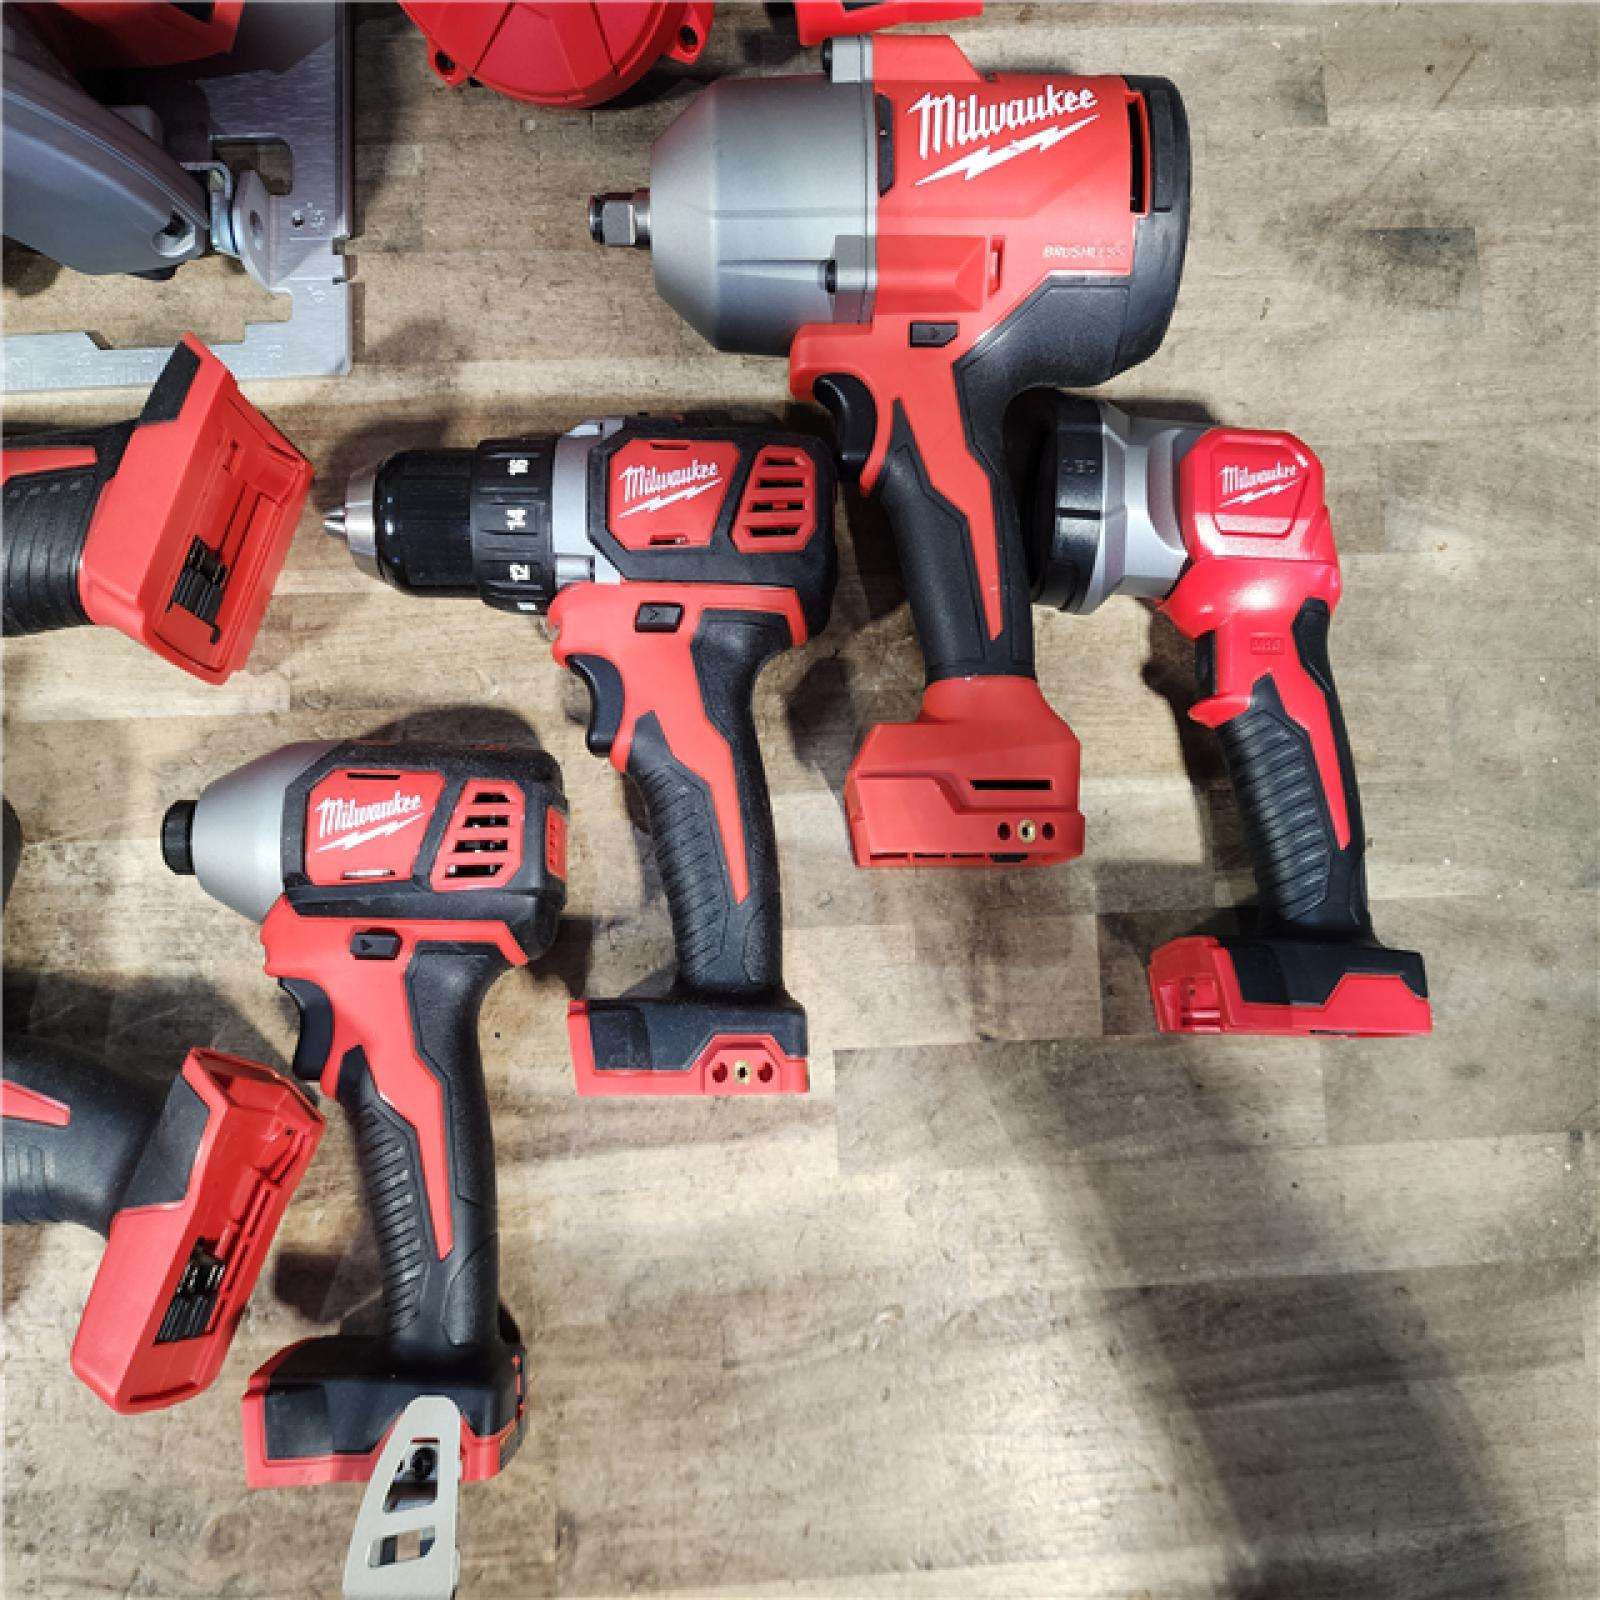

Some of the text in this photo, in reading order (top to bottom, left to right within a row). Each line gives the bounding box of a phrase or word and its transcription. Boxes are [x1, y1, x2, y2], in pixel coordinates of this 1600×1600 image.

[907, 85, 1099, 160] Milwaukee
[618, 459, 718, 503] Milwaukee
[1218, 461, 1297, 496] Milwaukee
[315, 789, 422, 838] Milwaukee
